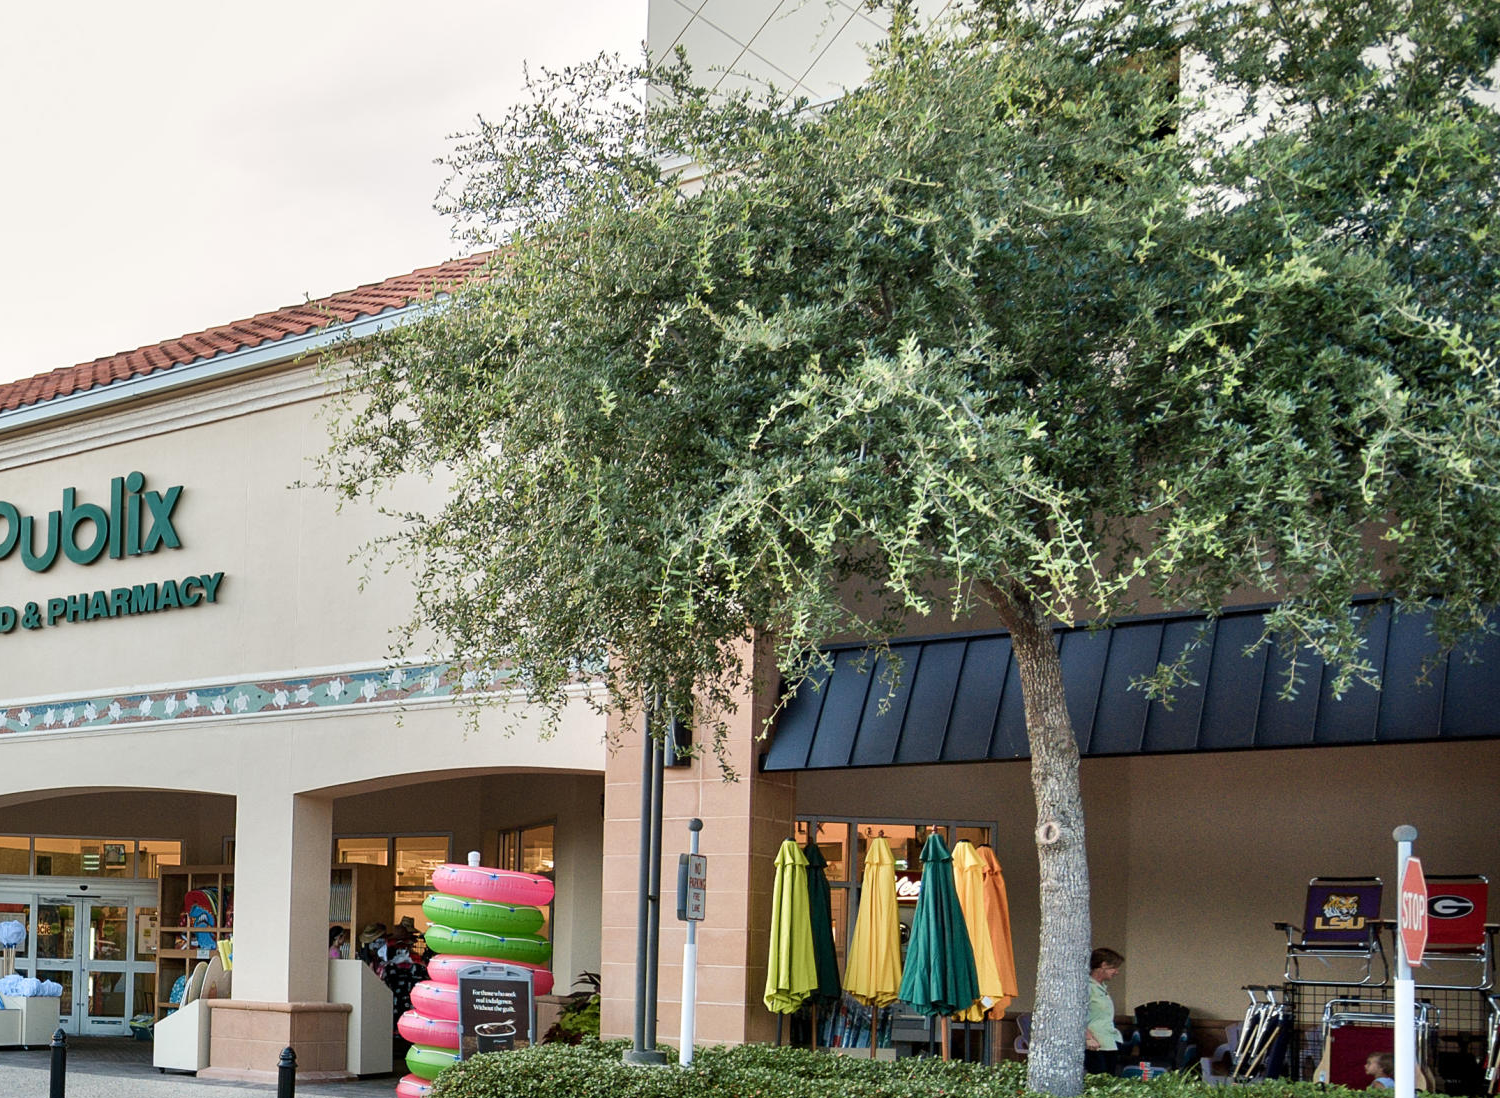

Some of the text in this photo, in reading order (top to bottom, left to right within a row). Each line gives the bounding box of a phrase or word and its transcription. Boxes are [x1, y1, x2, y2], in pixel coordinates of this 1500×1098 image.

[21, 601, 42, 630] &
[47, 572, 225, 626] PHARMACY
[1314, 916, 1365, 930] LSU
[1402, 891, 1426, 931] STOP
